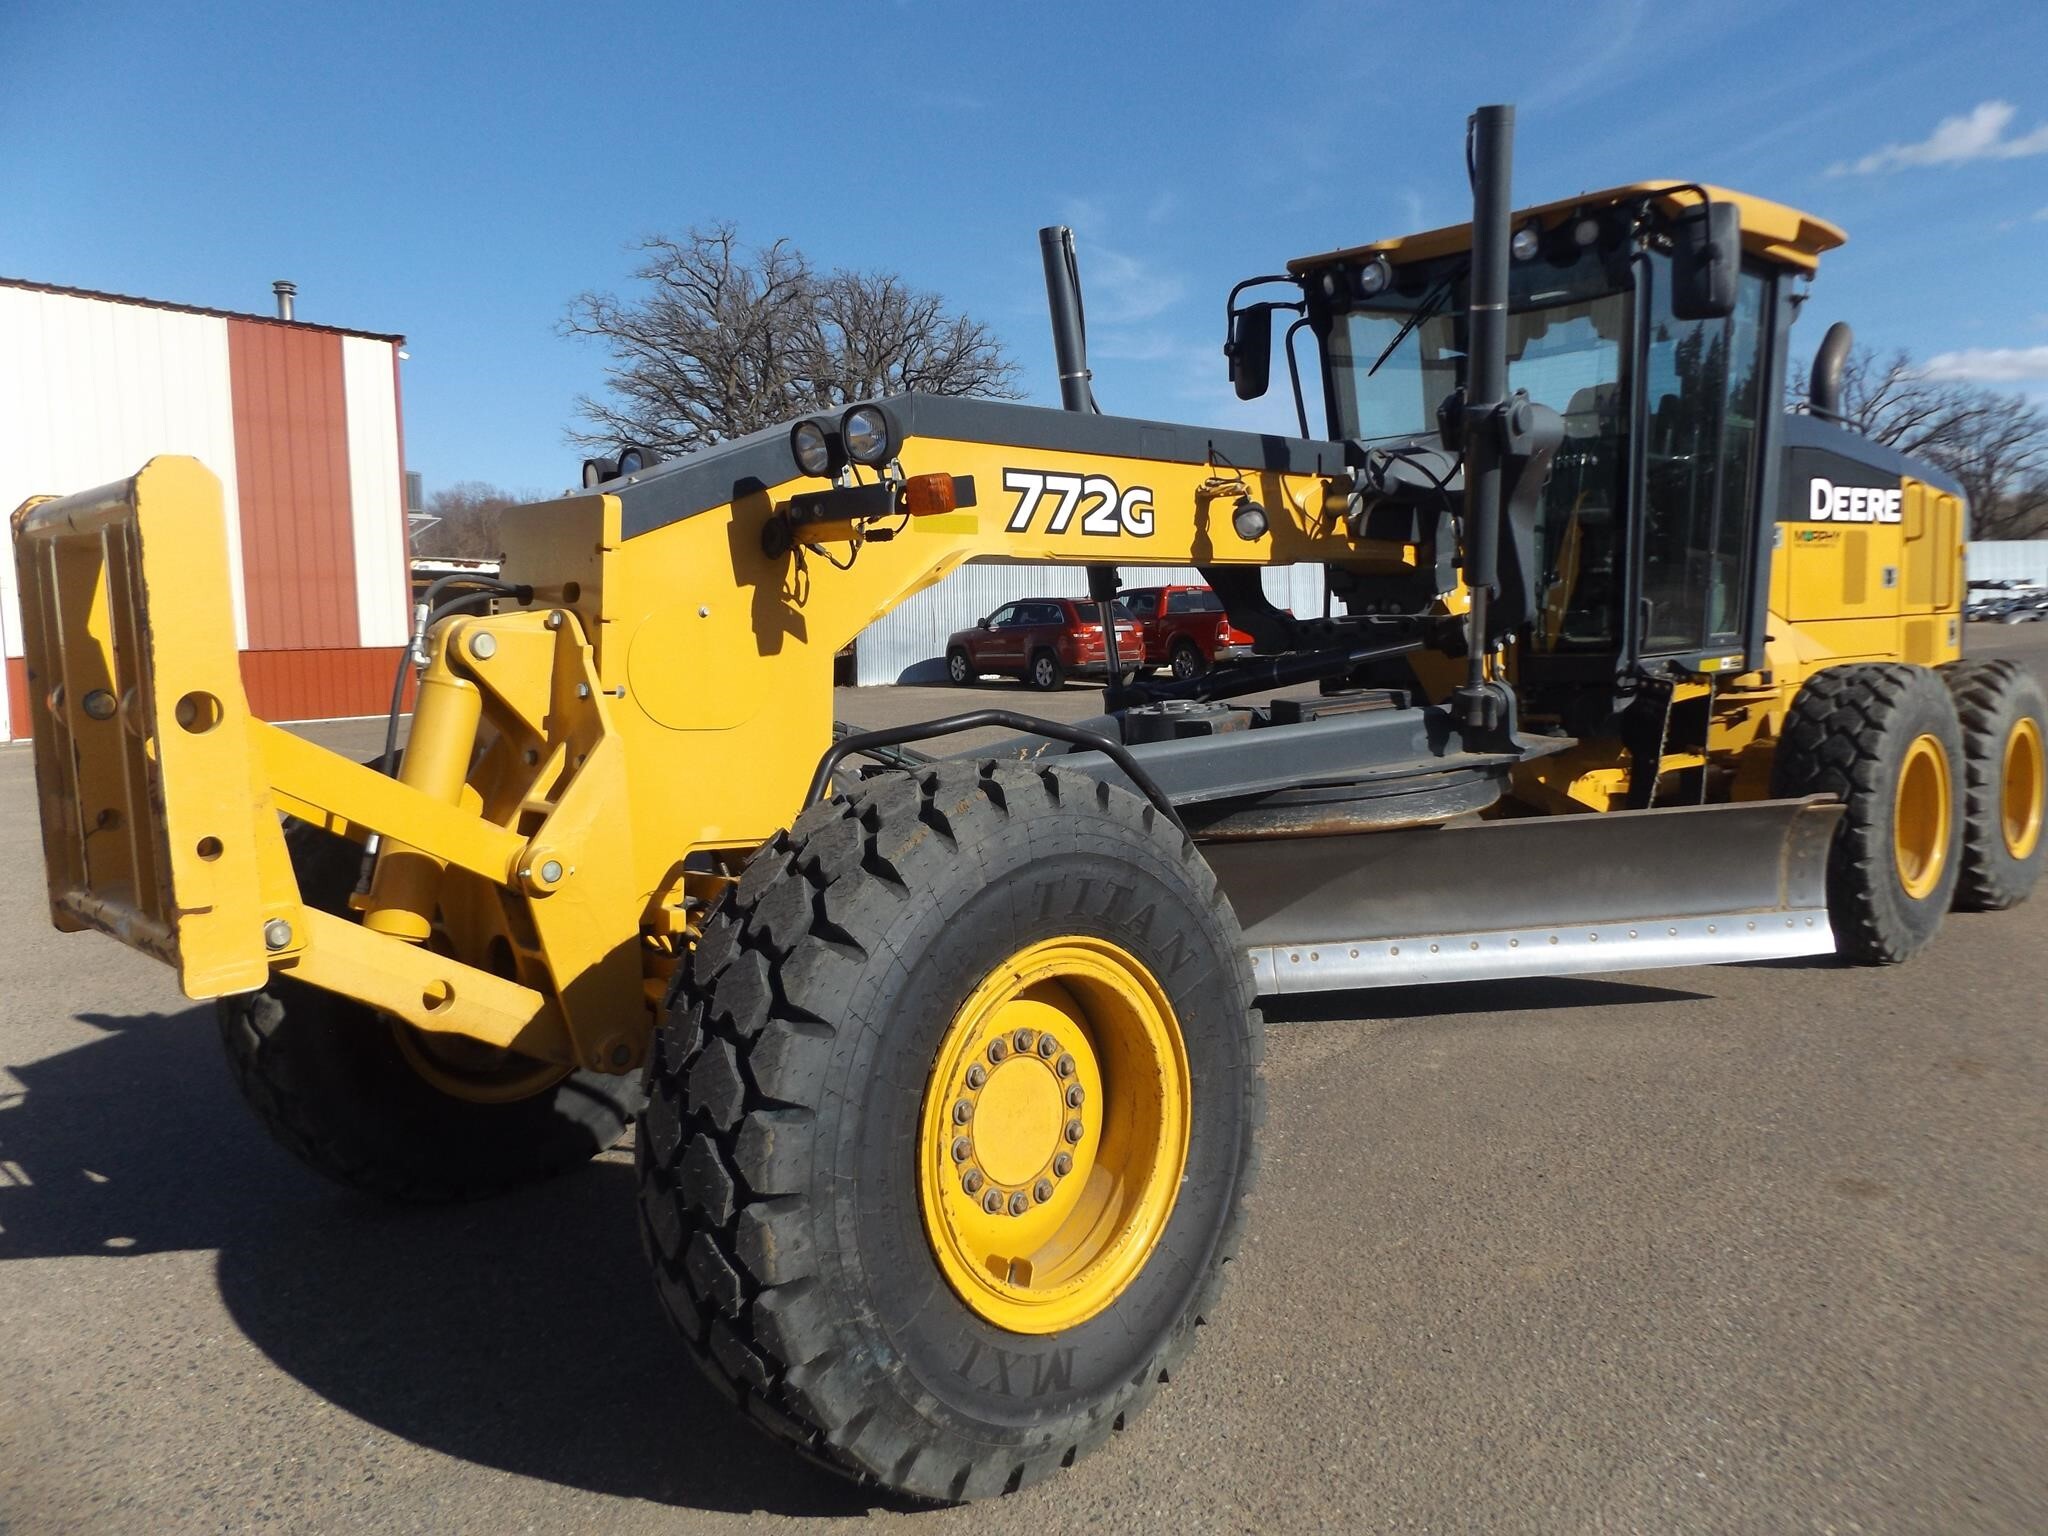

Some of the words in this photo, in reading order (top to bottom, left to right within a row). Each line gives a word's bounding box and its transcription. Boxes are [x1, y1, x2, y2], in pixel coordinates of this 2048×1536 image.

[1003, 467, 1154, 538] 772G
[1810, 478, 1903, 522] DEERE
[1032, 876, 1199, 978] TITAN
